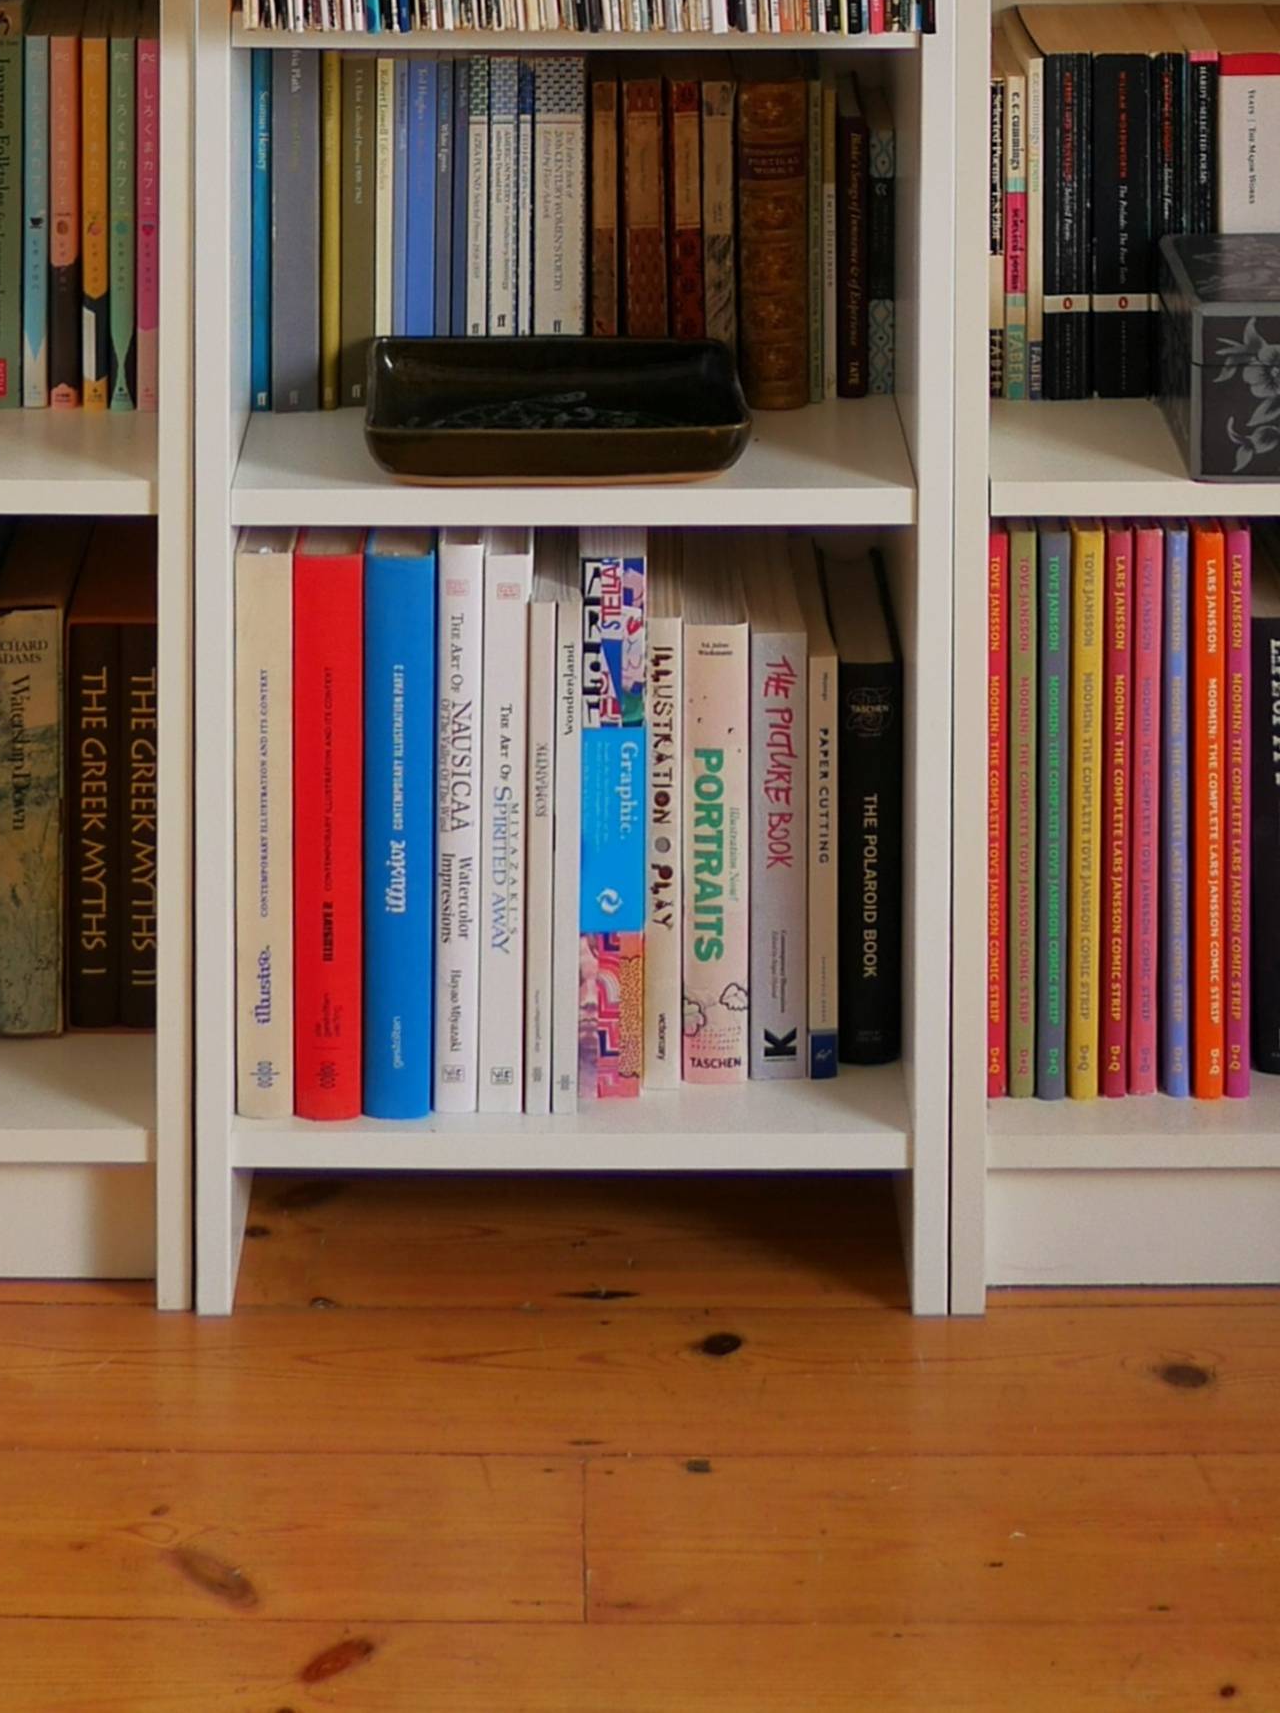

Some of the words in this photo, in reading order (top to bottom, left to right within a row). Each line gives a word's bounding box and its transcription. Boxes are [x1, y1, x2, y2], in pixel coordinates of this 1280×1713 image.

[256, 91, 268, 129] Seamus
[254, 132, 267, 171] Heaney
[847, 362, 858, 384] TATE
[1008, 330, 1022, 385] FABER
[1029, 347, 1039, 391] FABER
[1114, 556, 1124, 588] LARS
[1113, 591, 1124, 650] JANSSON
[80, 667, 106, 730] THE
[260, 668, 268, 715] CONTEXT
[561, 644, 576, 735] Wonderland
[763, 656, 796, 699] THE
[1113, 674, 1123, 736] MOOMIN:
[8, 675, 30, 770] Watership
[260, 718, 268, 733] ITS
[260, 736, 268, 756] AND
[764, 708, 797, 806] PICTURE
[817, 728, 828, 780] PAPER
[1113, 741, 1123, 765] THE
[11, 772, 28, 830] Down
[80, 738, 106, 831] GREEK
[260, 760, 268, 832] ILLUSTRATION
[614, 742, 638, 840] Graphic.
[862, 794, 877, 829] THE
[1112, 769, 1123, 835] COMPLETE
[765, 812, 792, 869] BOOK
[818, 786, 828, 864] CUTTING
[260, 835, 268, 916] CONTEMPORARY
[386, 839, 406, 912] illusive
[693, 747, 723, 963] PORTRAITS
[862, 835, 878, 923] POLAROID
[1111, 841, 1121, 872] LARS
[80, 839, 105, 950] MYTHS
[438, 853, 455, 943] Impressions
[456, 857, 472, 940] Watercolor
[489, 892, 509, 954] AWAY
[1110, 876, 1121, 934] JANSSON
[862, 929, 878, 978] BOOK
[1110, 938, 1120, 979] COMIC
[446, 970, 460, 1006] Hayao
[1110, 983, 1120, 1020] STRIP
[447, 1008, 462, 1051] Miyazaki
[689, 1057, 740, 1068] TASCHEN
